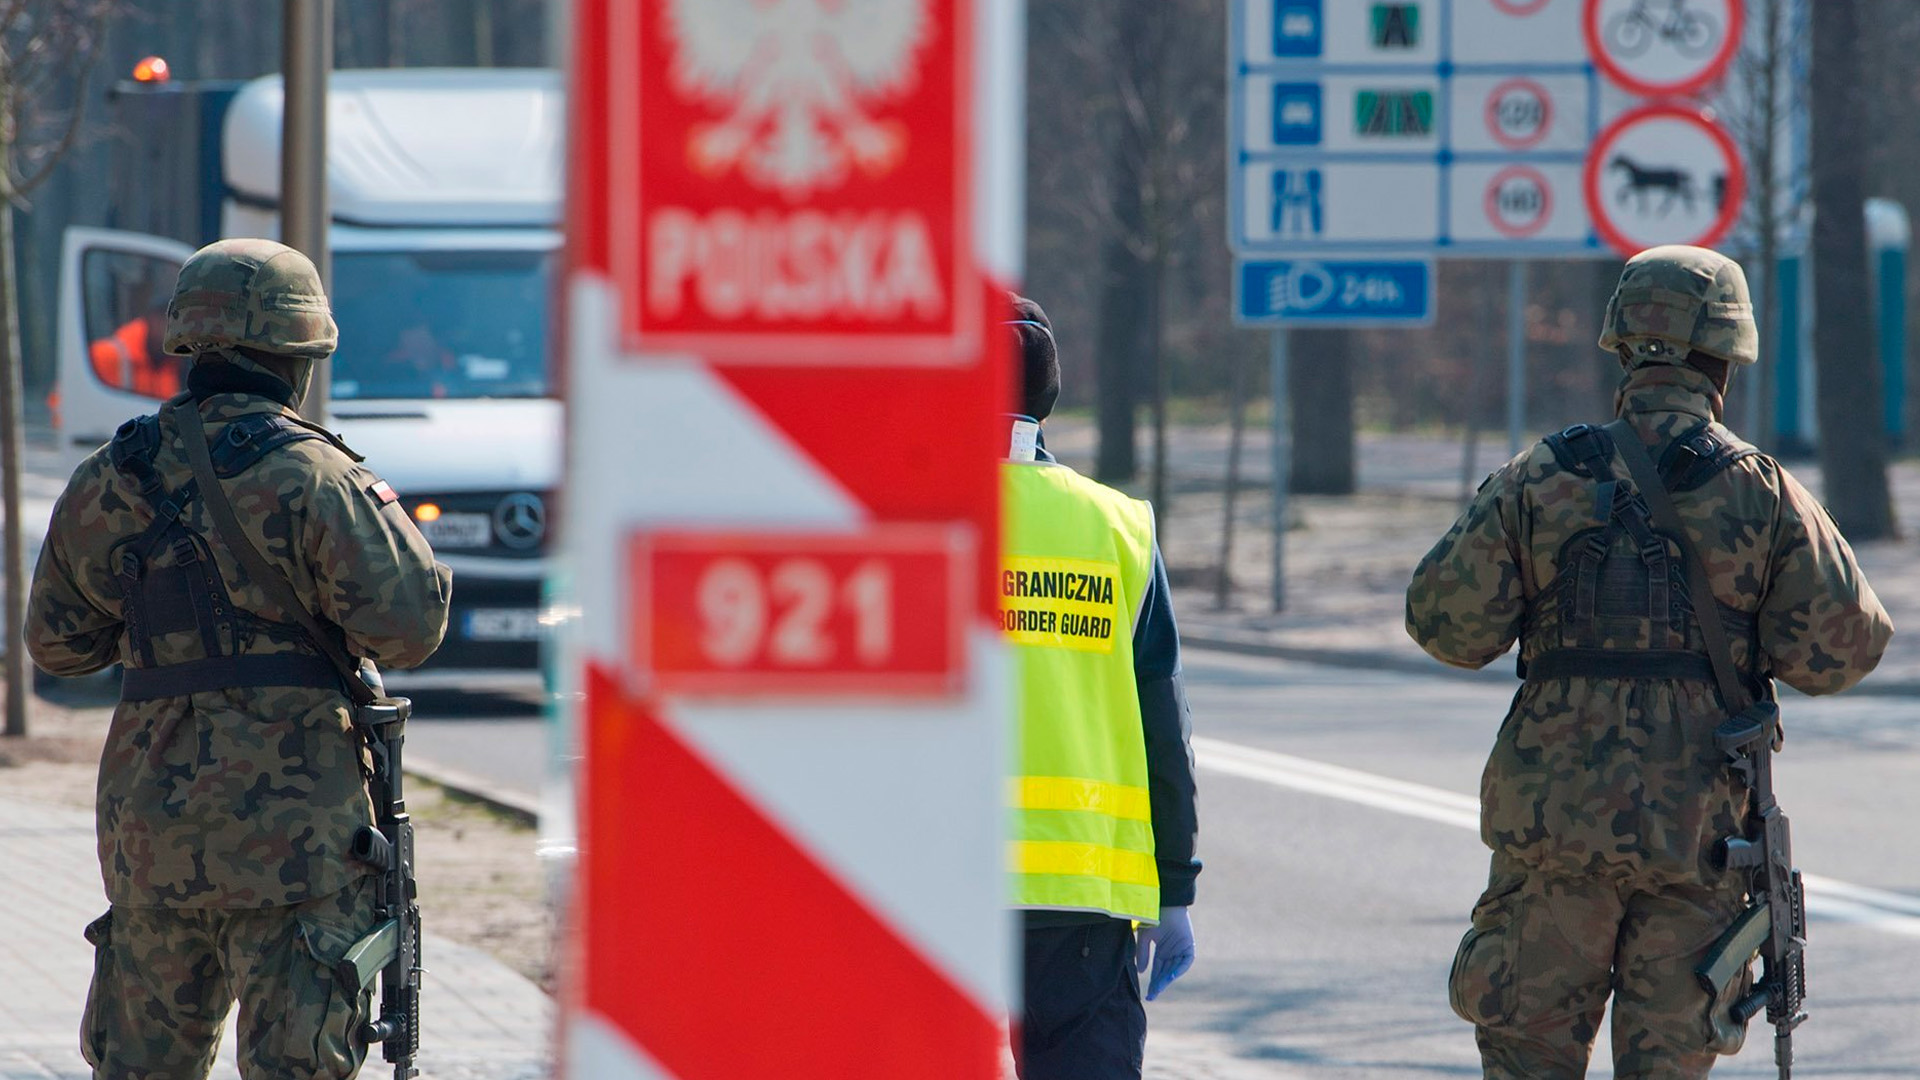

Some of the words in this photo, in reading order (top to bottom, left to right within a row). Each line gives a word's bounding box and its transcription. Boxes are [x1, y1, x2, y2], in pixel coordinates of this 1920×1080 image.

[650, 209, 942, 318] POLSKA
[698, 557, 894, 664] 921
[1002, 570, 1113, 604] GRANICZNA
[997, 609, 1056, 633] BORDER
[1061, 613, 1111, 639] GUARD
